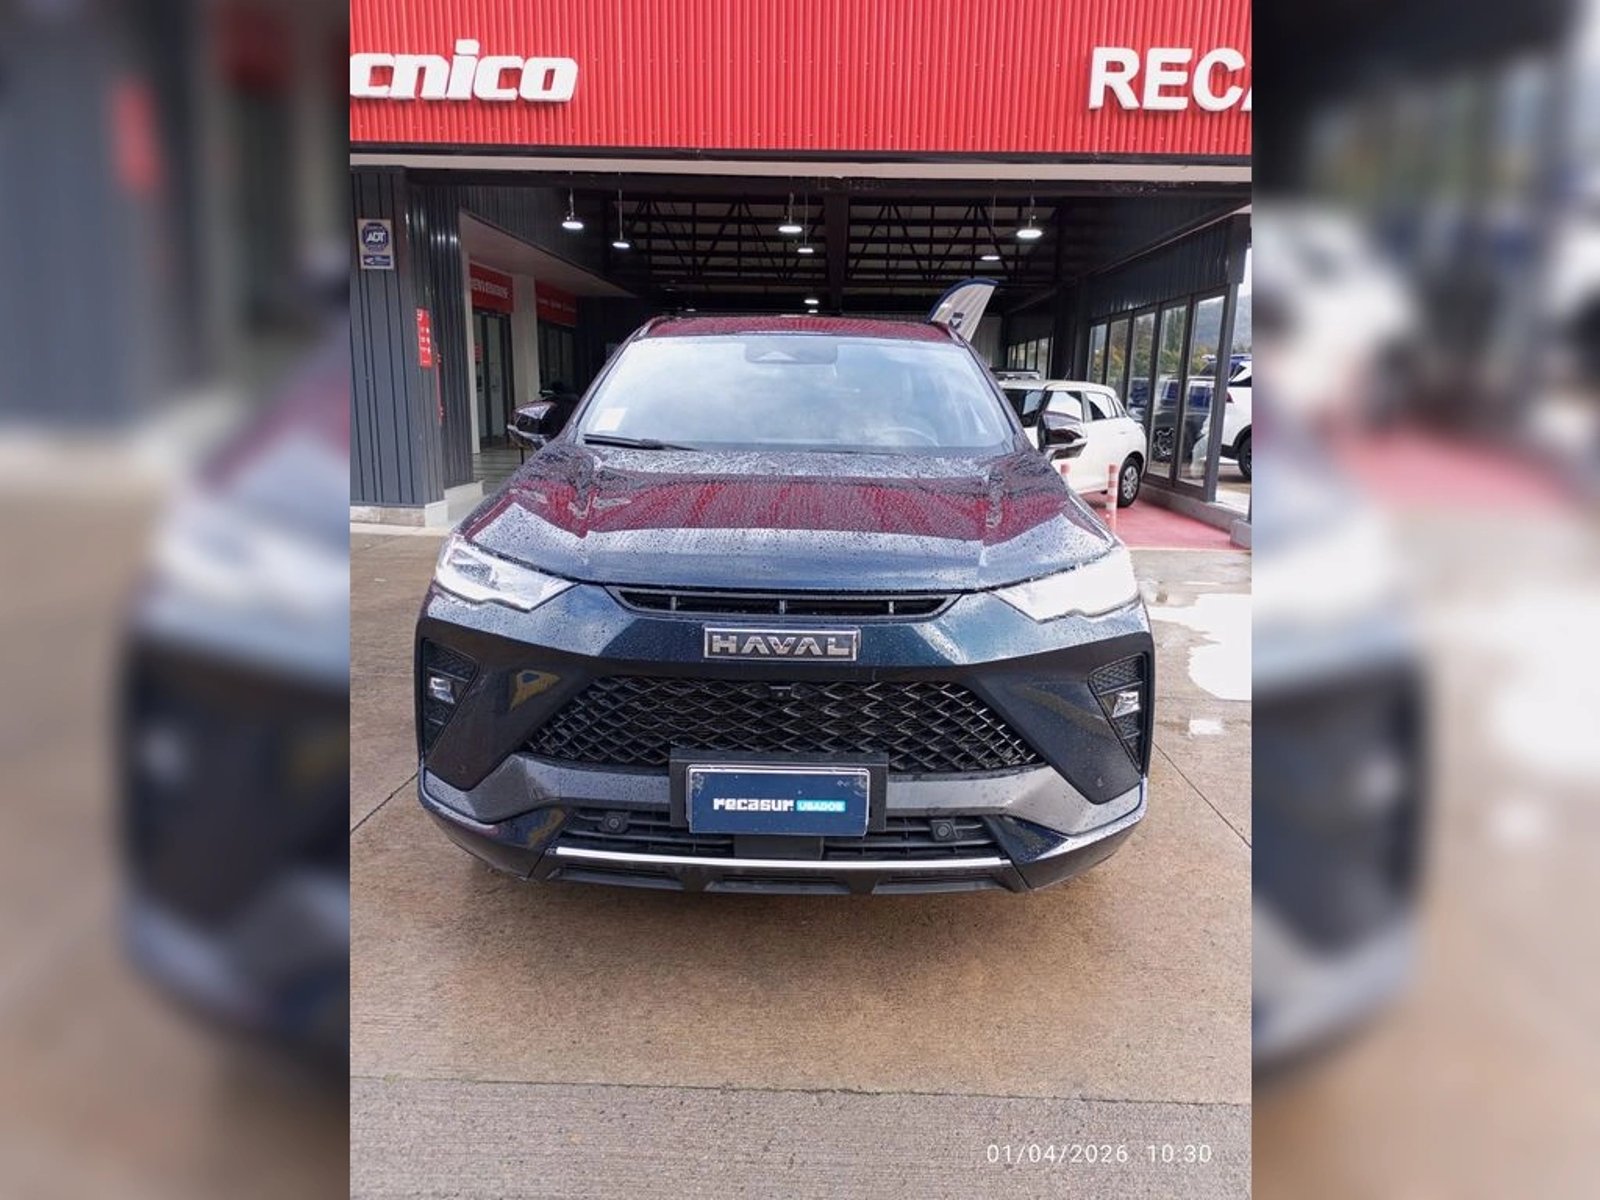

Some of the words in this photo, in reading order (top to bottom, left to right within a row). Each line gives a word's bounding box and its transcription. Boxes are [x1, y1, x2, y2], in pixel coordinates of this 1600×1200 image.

[350, 39, 579, 103] cnico
[366, 232, 386, 243] ADT
[711, 634, 851, 656] HAVAL
